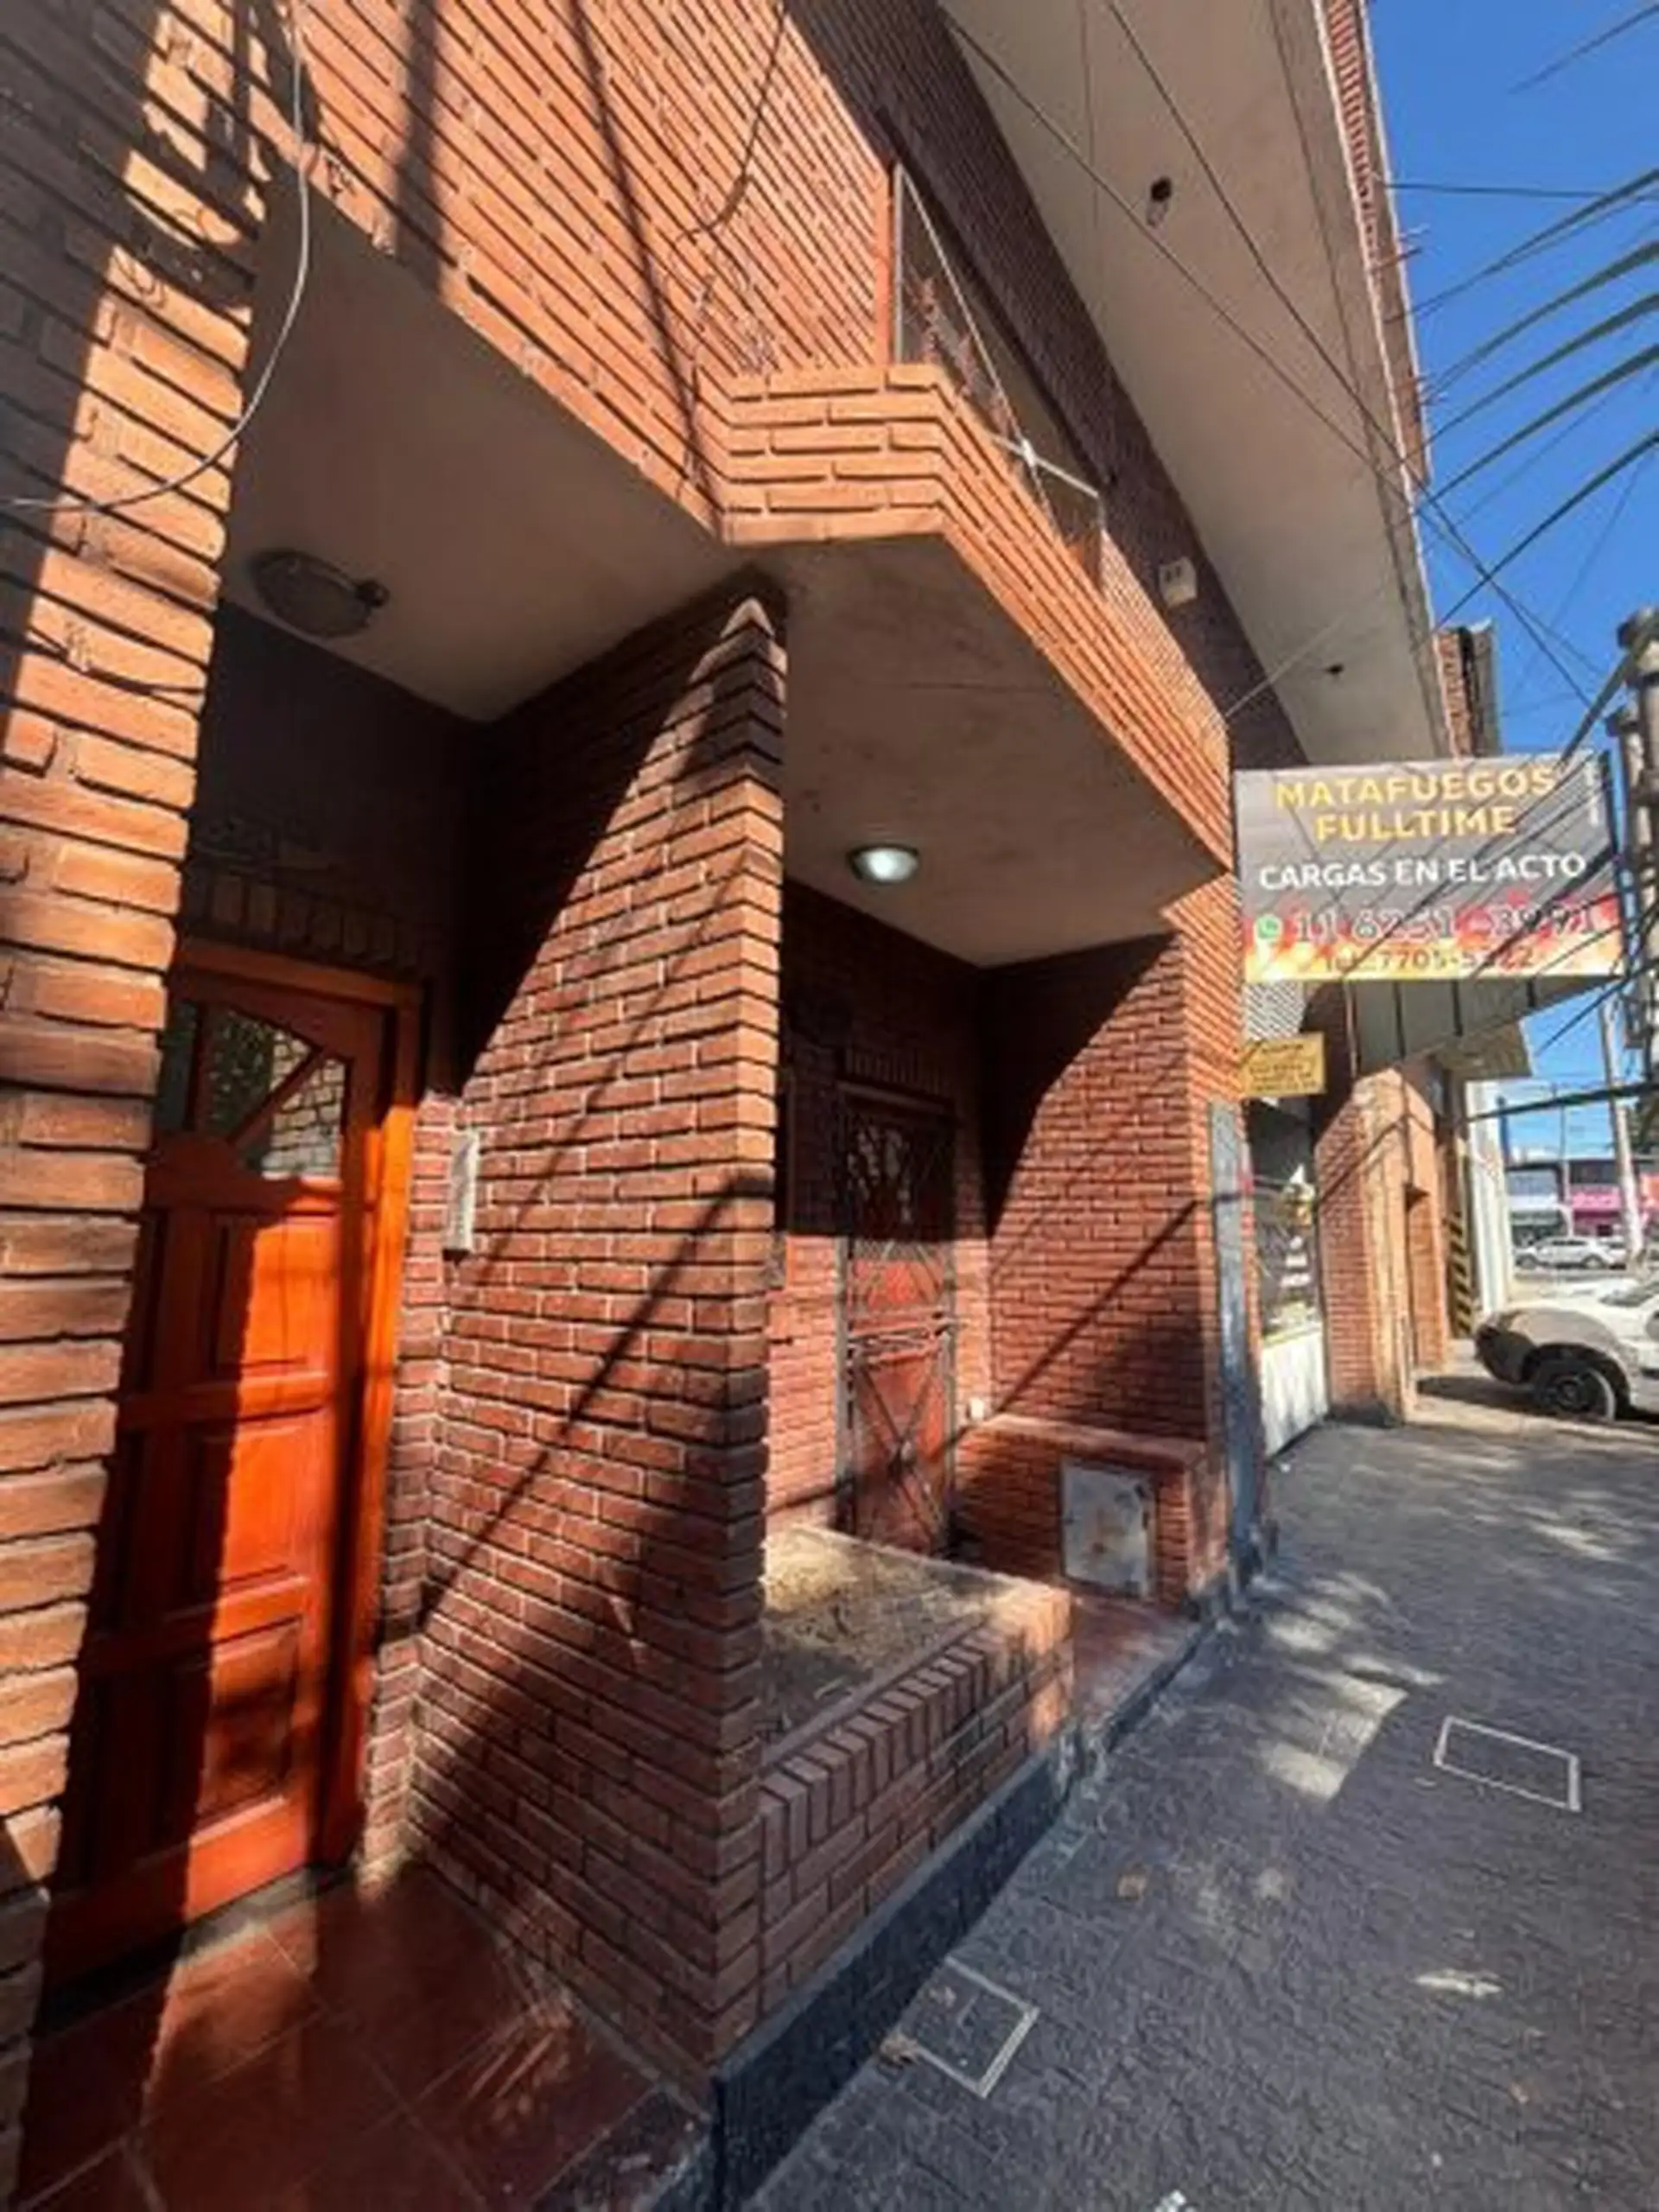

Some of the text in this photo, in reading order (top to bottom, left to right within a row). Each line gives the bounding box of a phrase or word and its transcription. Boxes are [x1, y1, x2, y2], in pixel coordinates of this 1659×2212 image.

[1275, 764, 1556, 809] MATAFUEGOS
[1314, 804, 1518, 842] FULLTIME
[1259, 850, 1587, 891] CARGAS EN EL ACTO
